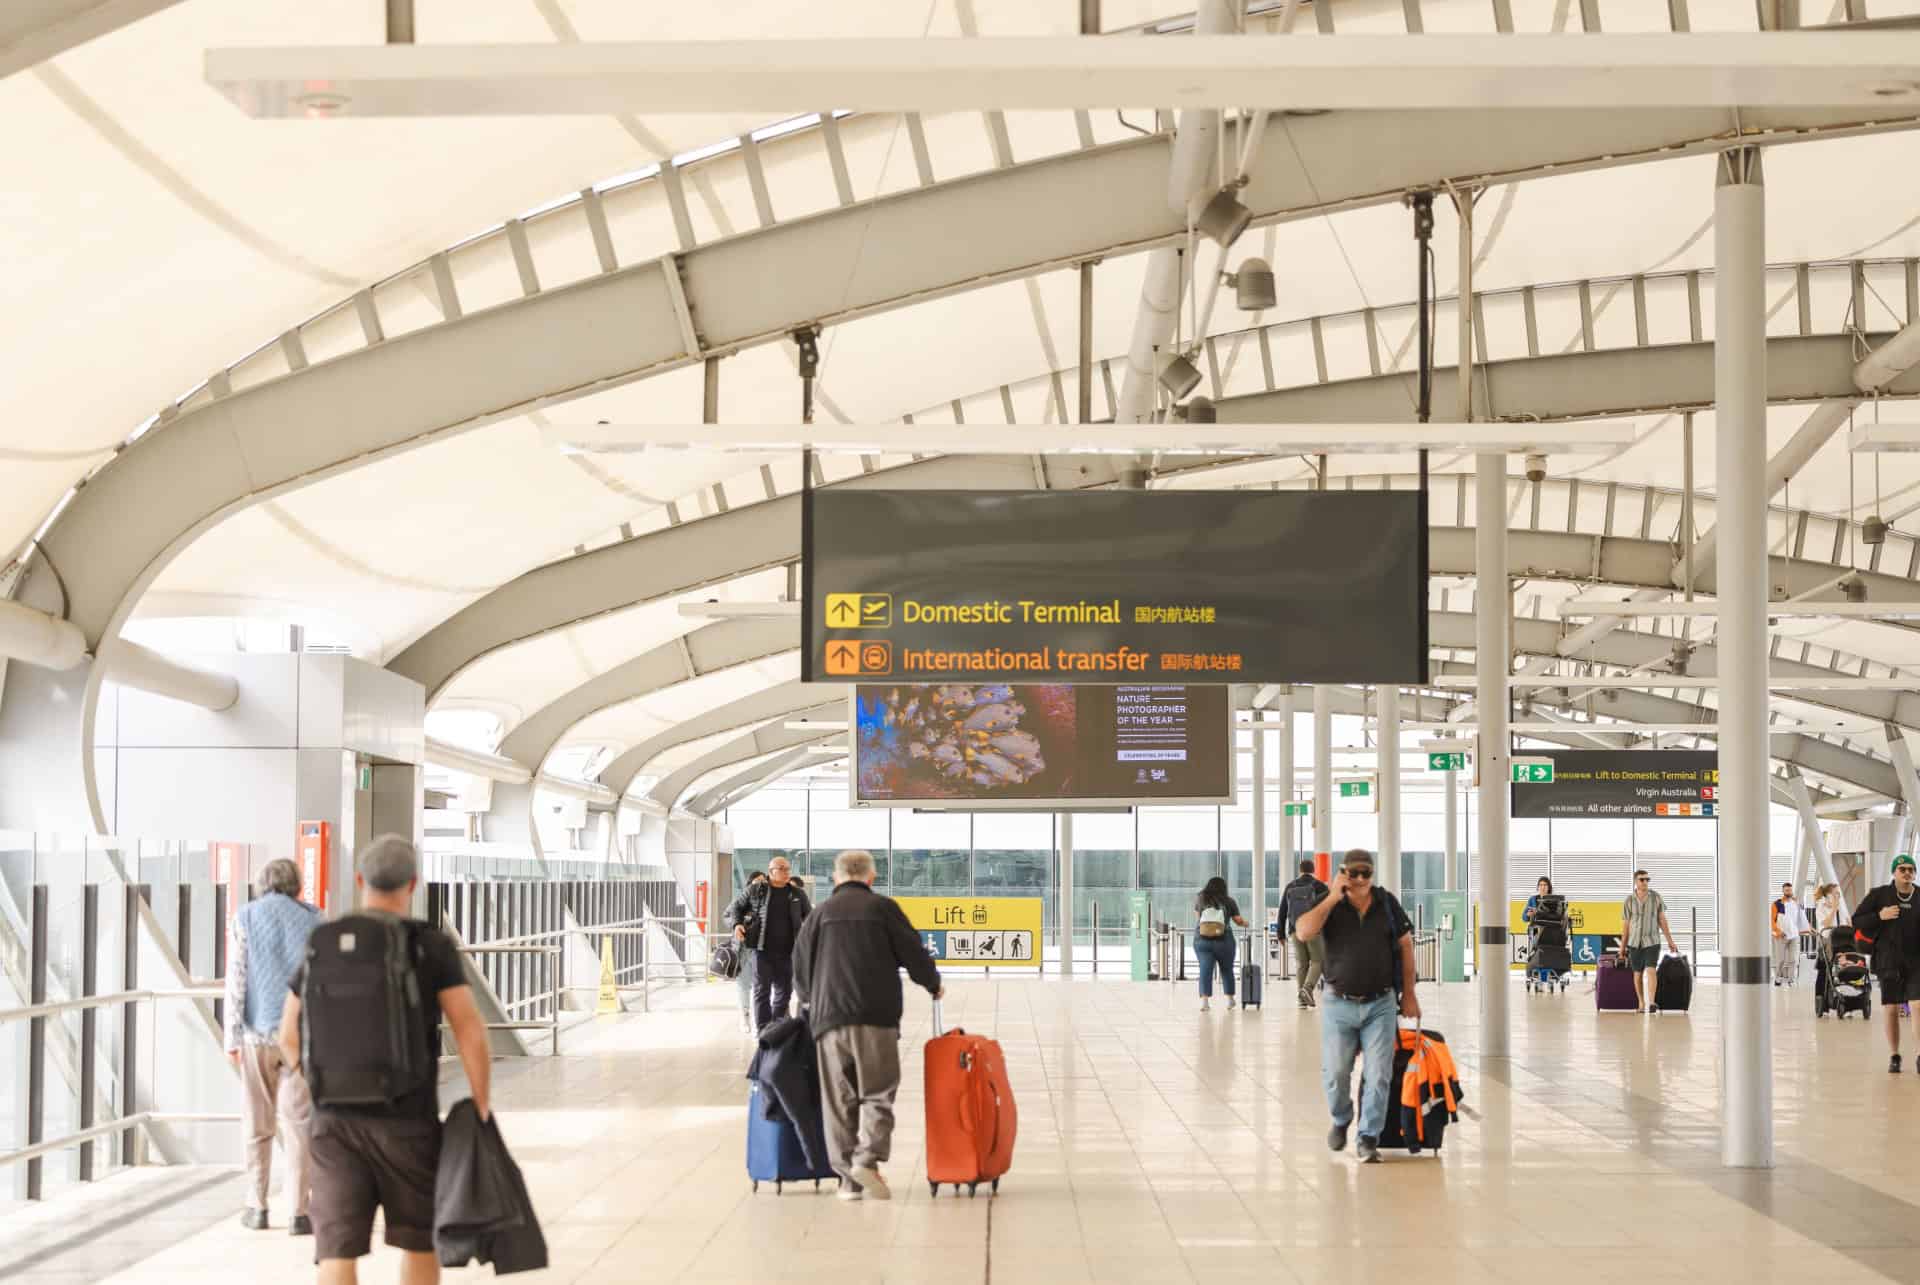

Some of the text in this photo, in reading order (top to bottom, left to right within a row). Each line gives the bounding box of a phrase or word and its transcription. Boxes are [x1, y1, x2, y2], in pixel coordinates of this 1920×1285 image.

[903, 599, 1120, 623] Domestic Terminal
[903, 646, 1149, 670] International transfer
[1116, 695, 1151, 703] NATURE
[1116, 705, 1186, 713] PHOTOGRAPHER
[1117, 716, 1173, 725] OF THE YEAR
[1595, 770, 1609, 780] Lift
[1611, 771, 1619, 780] to
[1621, 770, 1659, 780] Domestic
[1661, 770, 1697, 780] Terminal
[1635, 787, 1697, 799] Virgin Australia
[1587, 803, 1599, 813] All
[1600, 803, 1621, 813] other
[1623, 803, 1652, 813] airlines
[934, 906, 966, 924] Lift
